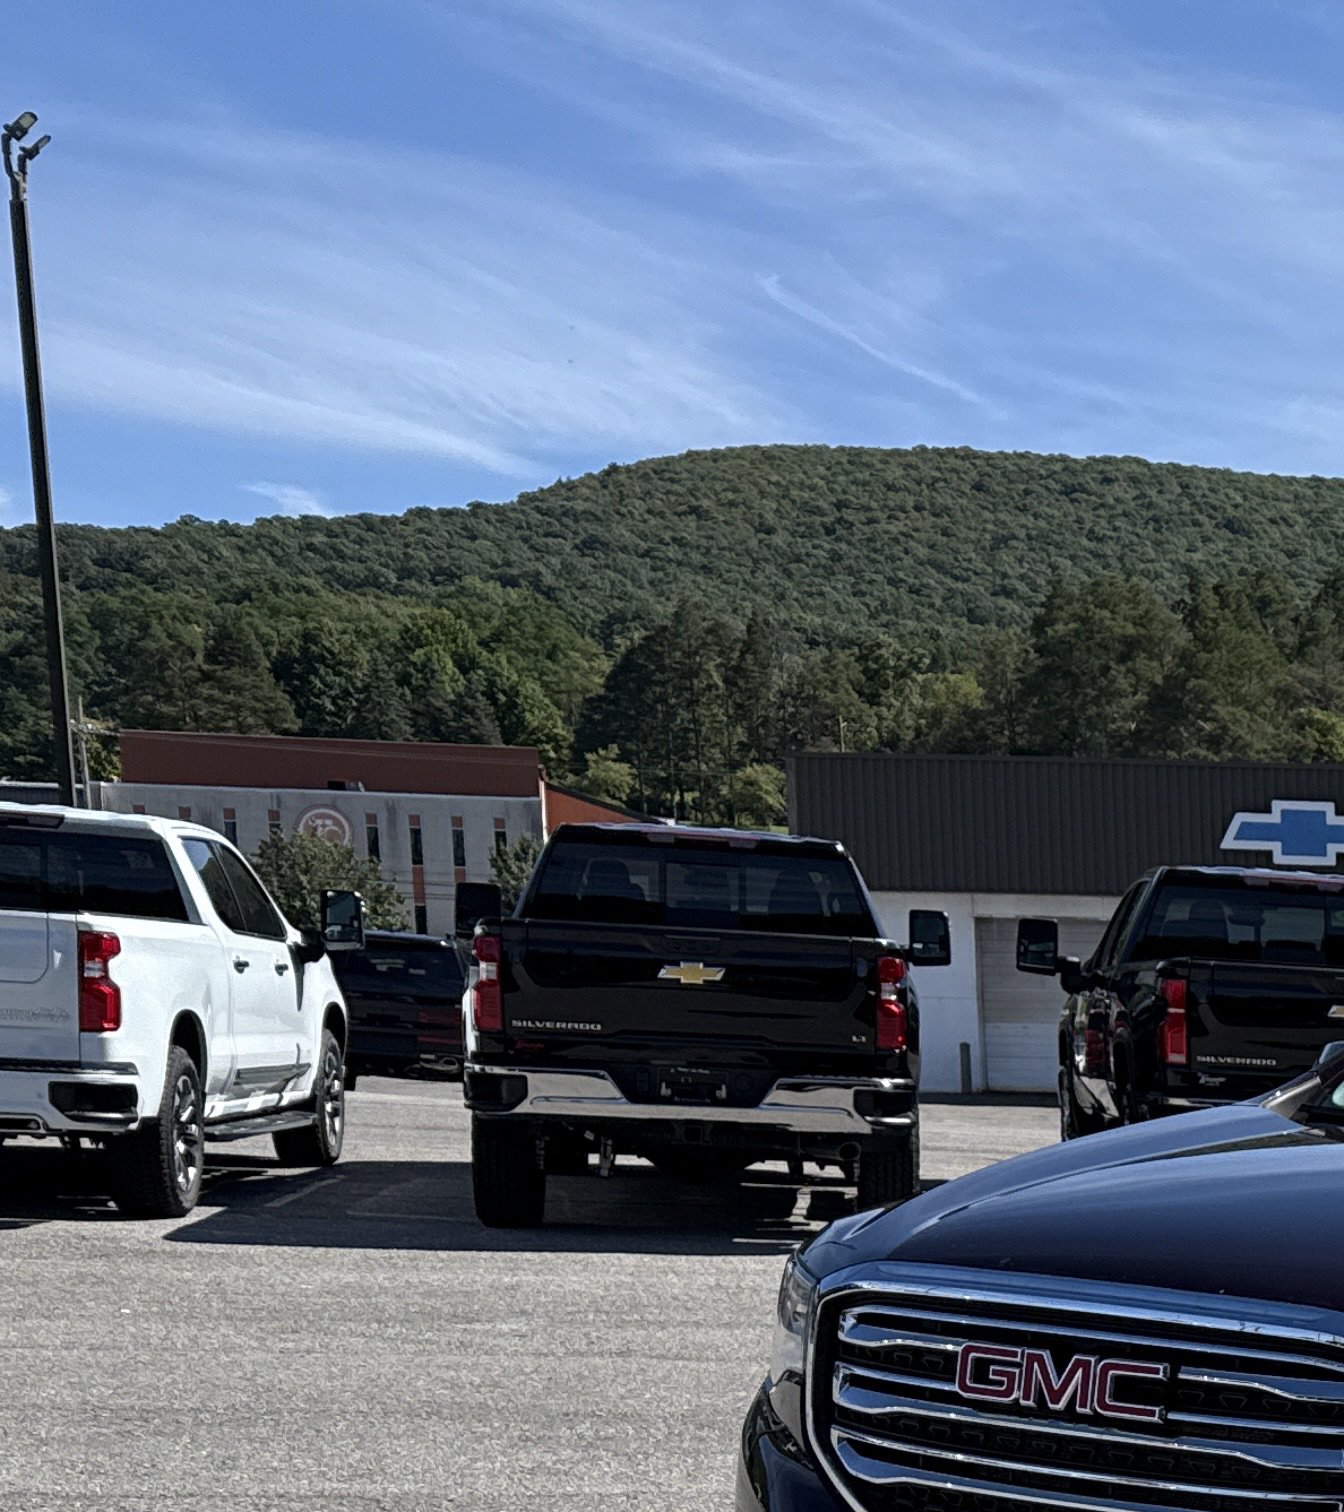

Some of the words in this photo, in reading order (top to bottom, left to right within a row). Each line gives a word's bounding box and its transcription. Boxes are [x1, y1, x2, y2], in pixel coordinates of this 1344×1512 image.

[512, 1019, 602, 1031] SILVERADO
[1196, 1055, 1276, 1066] SILVERADO
[956, 1343, 1170, 1423] GMC
